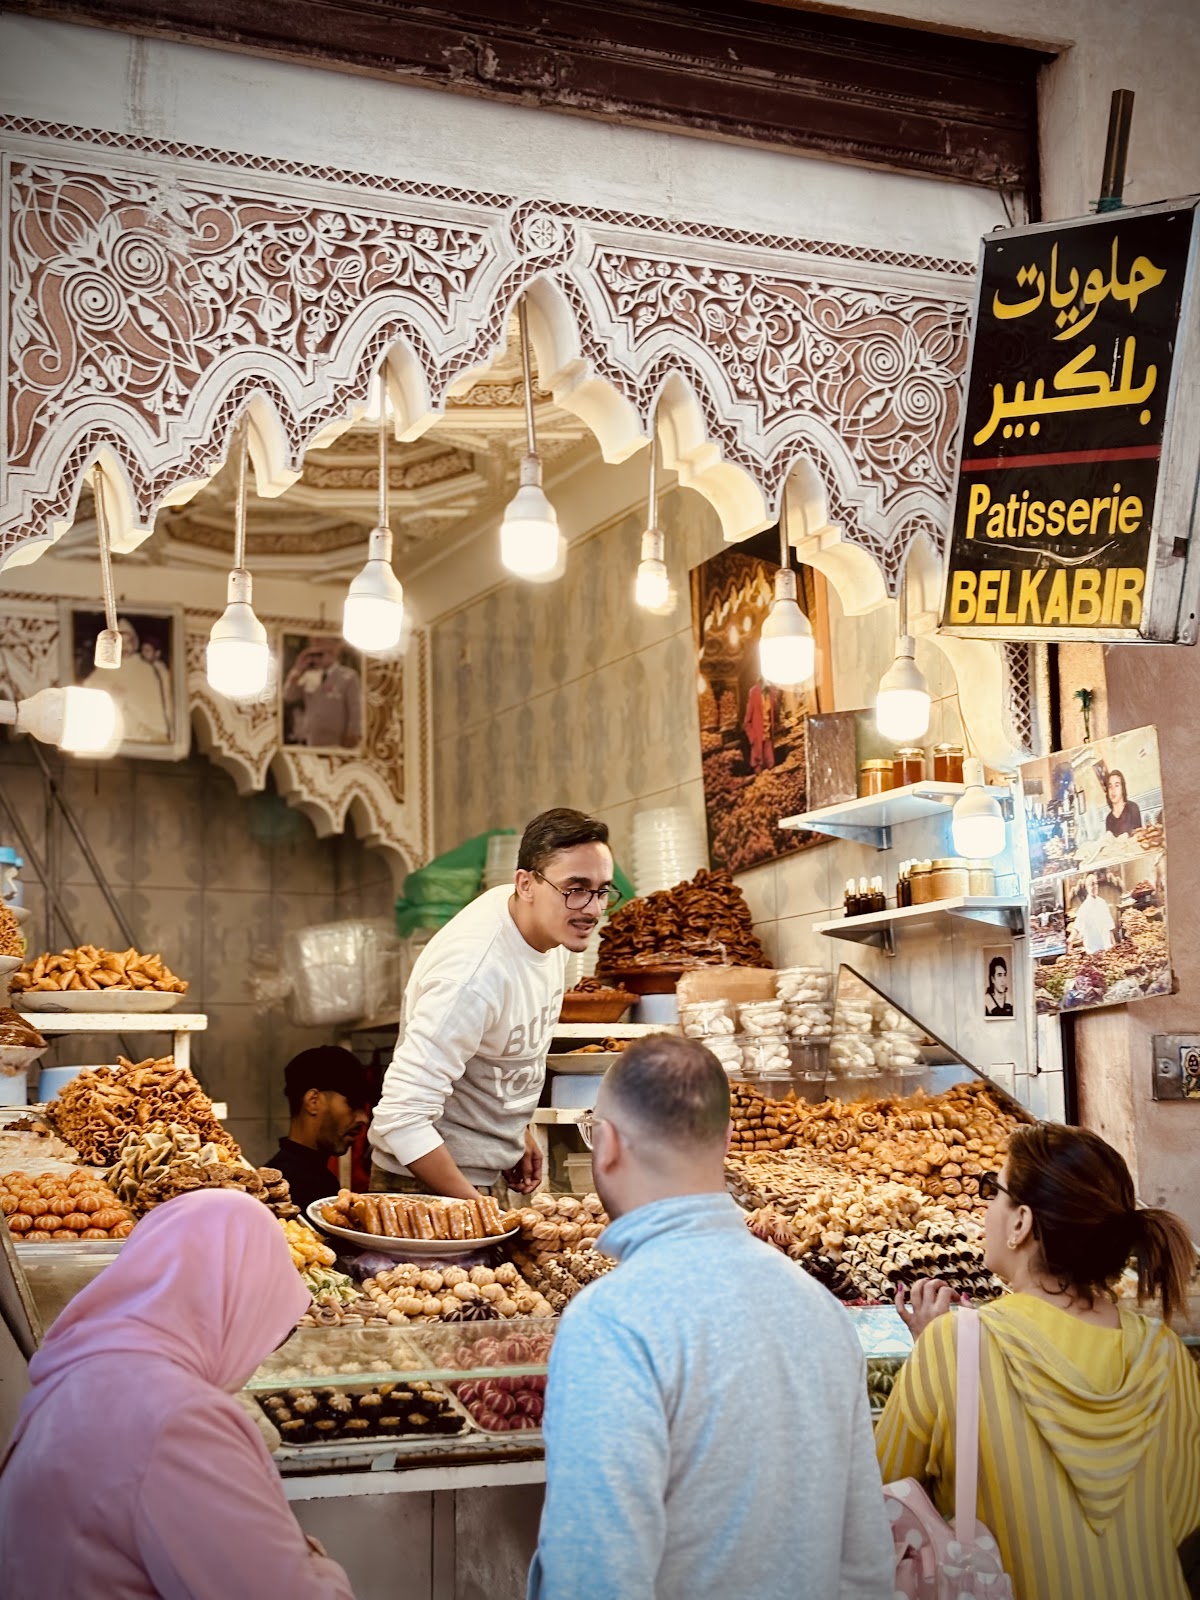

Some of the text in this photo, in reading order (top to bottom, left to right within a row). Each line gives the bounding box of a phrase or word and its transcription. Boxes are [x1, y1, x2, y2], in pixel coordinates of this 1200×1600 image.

[993, 236, 1167, 340] حلويات
[974, 335, 1157, 445] بلكبير
[966, 483, 1143, 539] Patisserie
[950, 567, 1145, 624] BELKABIR
